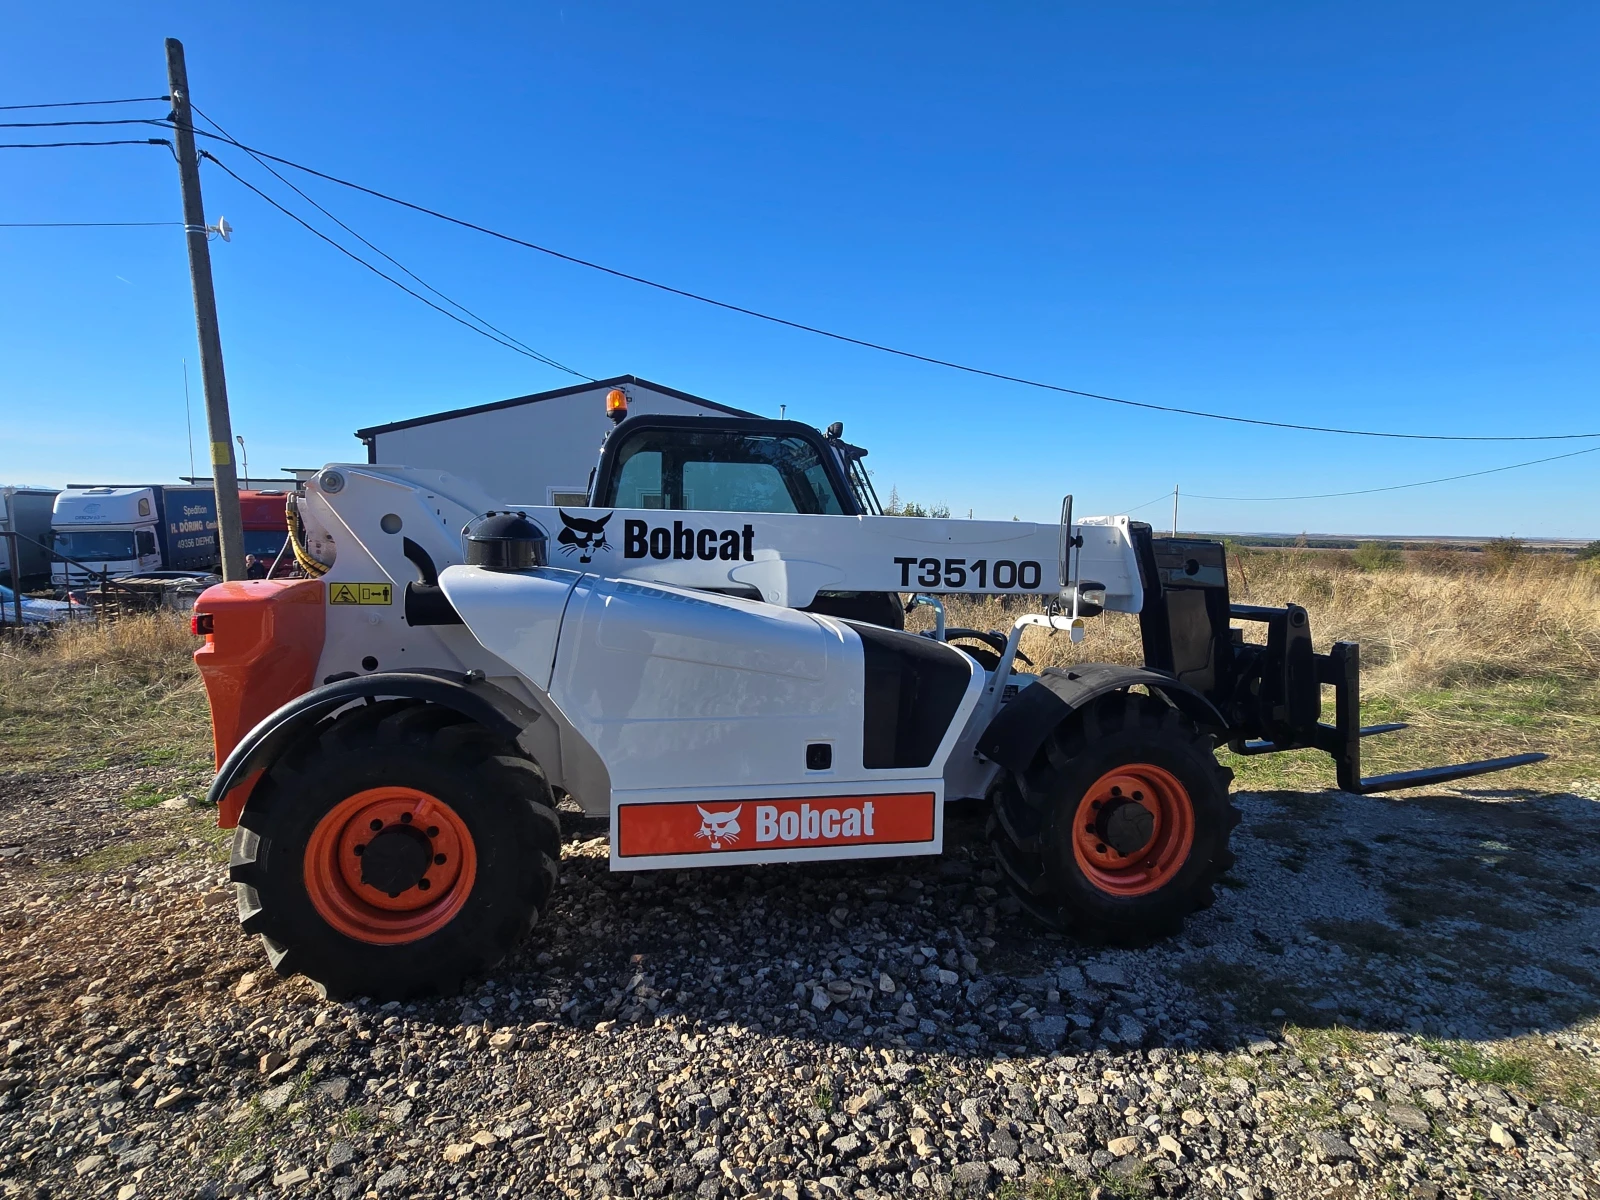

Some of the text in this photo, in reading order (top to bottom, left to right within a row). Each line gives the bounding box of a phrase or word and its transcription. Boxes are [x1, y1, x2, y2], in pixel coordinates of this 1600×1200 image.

[183, 505, 208, 516] Spedition
[179, 519, 203, 532] DÖRING
[195, 535, 215, 546] DIEPHOL
[624, 519, 754, 562] Bobcat
[893, 557, 1041, 589] T35100
[756, 801, 874, 842] Bobcat
